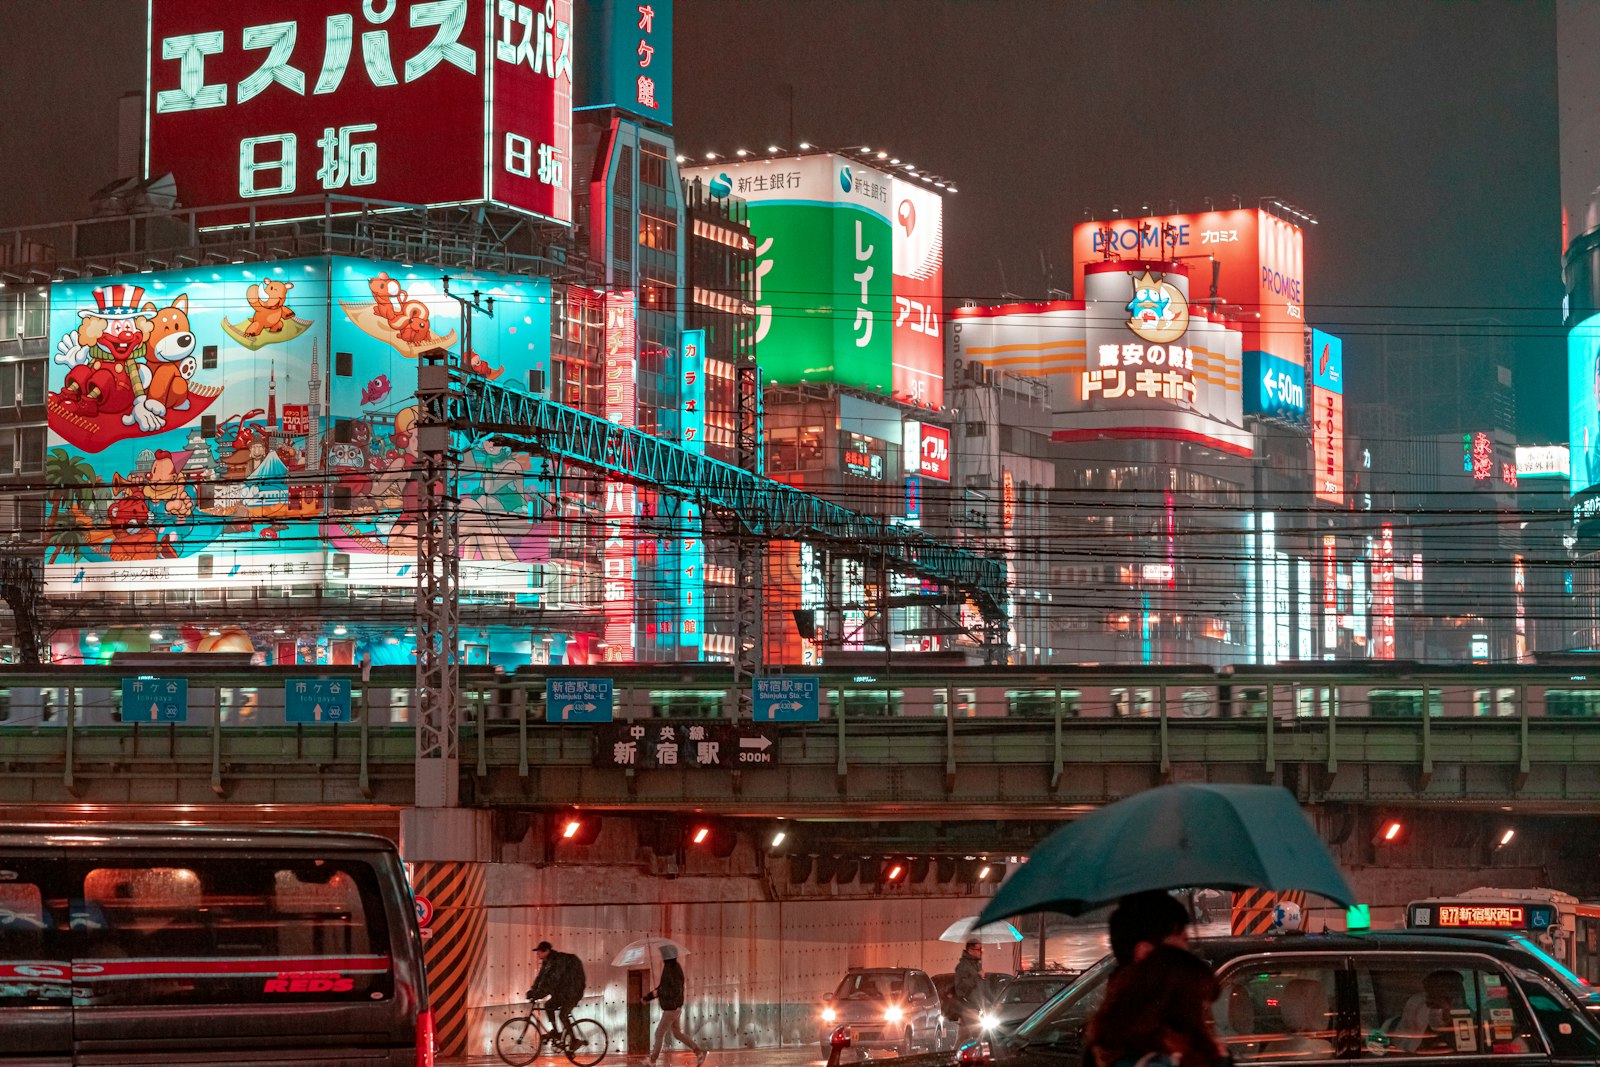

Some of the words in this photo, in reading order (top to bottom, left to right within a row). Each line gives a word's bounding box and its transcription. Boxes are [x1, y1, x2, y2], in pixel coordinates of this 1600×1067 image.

[496, 0, 571, 85] エスパス
[637, 4, 656, 108] オケ館
[155, 0, 477, 114] エスパス
[238, 123, 378, 198] 日拓
[505, 132, 563, 188] 日拓
[737, 172, 801, 193] 新生銀行
[854, 176, 887, 204] 新生銀行
[1200, 230, 1239, 244] プロミス
[1262, 265, 1300, 303] PROMISE
[895, 295, 939, 338] アコム
[953, 322, 963, 353] Don
[606, 307, 624, 404] パチンコ
[685, 344, 697, 441] カラオケ
[911, 379, 925, 401] 3F
[1278, 372, 1304, 409] 50m
[1326, 396, 1335, 477] PROMISE
[552, 681, 608, 693] 新宿駅東口
[554, 692, 582, 701] Shinjuku
[757, 680, 813, 692] 新宿駅東口
[759, 691, 787, 700] Shinjuku
[631, 725, 705, 740] 中央線
[613, 741, 720, 765] 新宿駅
[739, 752, 770, 763] 300M
[1460, 907, 1522, 921] 新宿駅西口
[264, 979, 354, 993] REDS
